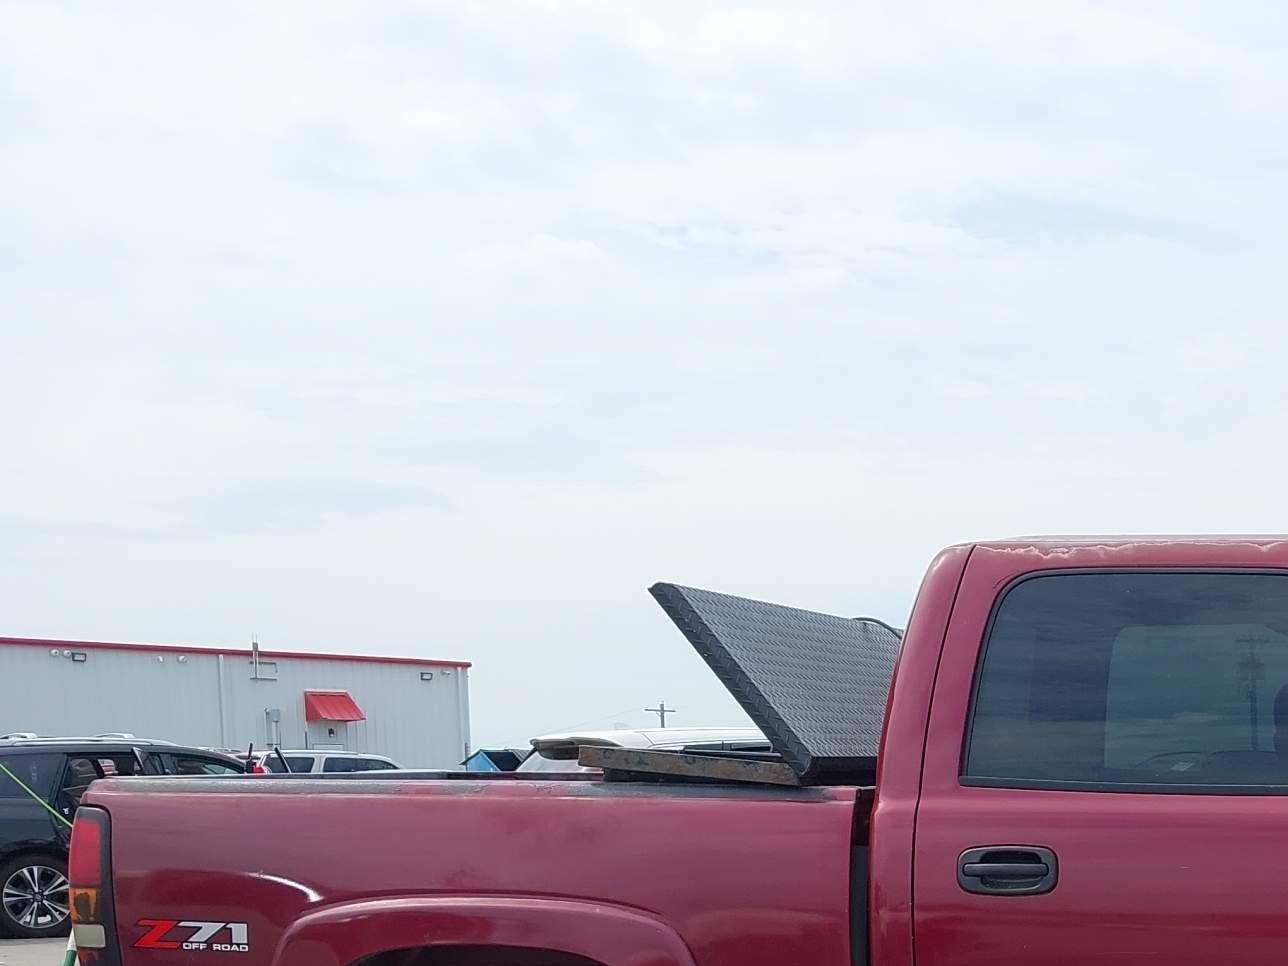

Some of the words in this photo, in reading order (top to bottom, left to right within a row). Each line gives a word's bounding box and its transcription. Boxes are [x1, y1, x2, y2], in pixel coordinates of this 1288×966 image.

[131, 918, 249, 949] Z71
[182, 942, 208, 951] OFF
[212, 943, 249, 952] ROAD
